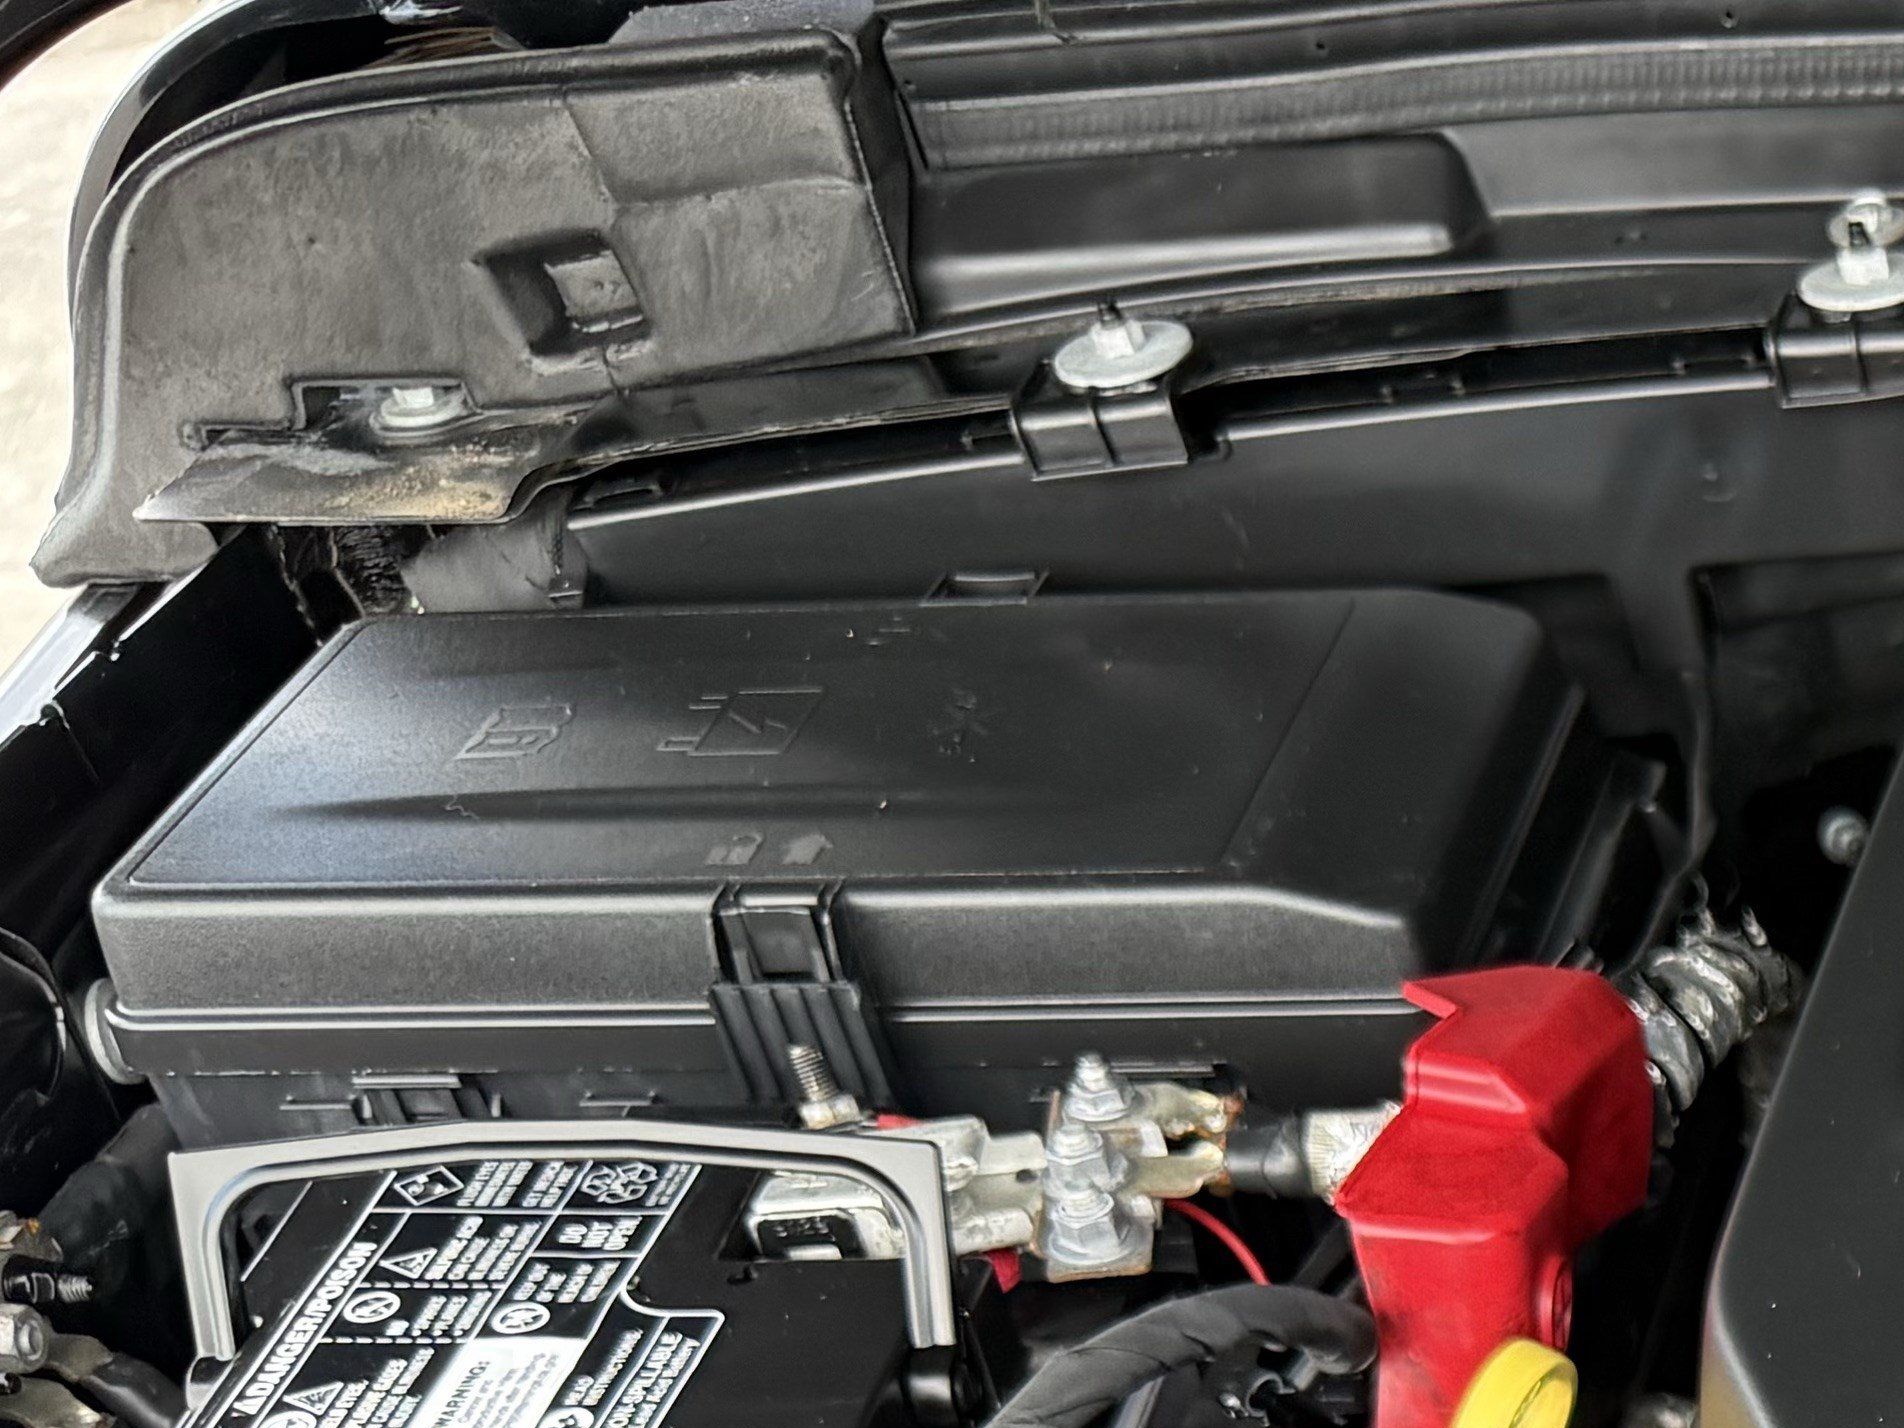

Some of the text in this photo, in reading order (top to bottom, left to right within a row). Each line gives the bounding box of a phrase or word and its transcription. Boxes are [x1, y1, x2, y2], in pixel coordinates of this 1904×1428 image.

[558, 1224, 588, 1244] DO
[581, 1221, 613, 1248] NOT
[247, 1242, 375, 1397] DANGER/POISON
[433, 1361, 489, 1428] WARNING:
